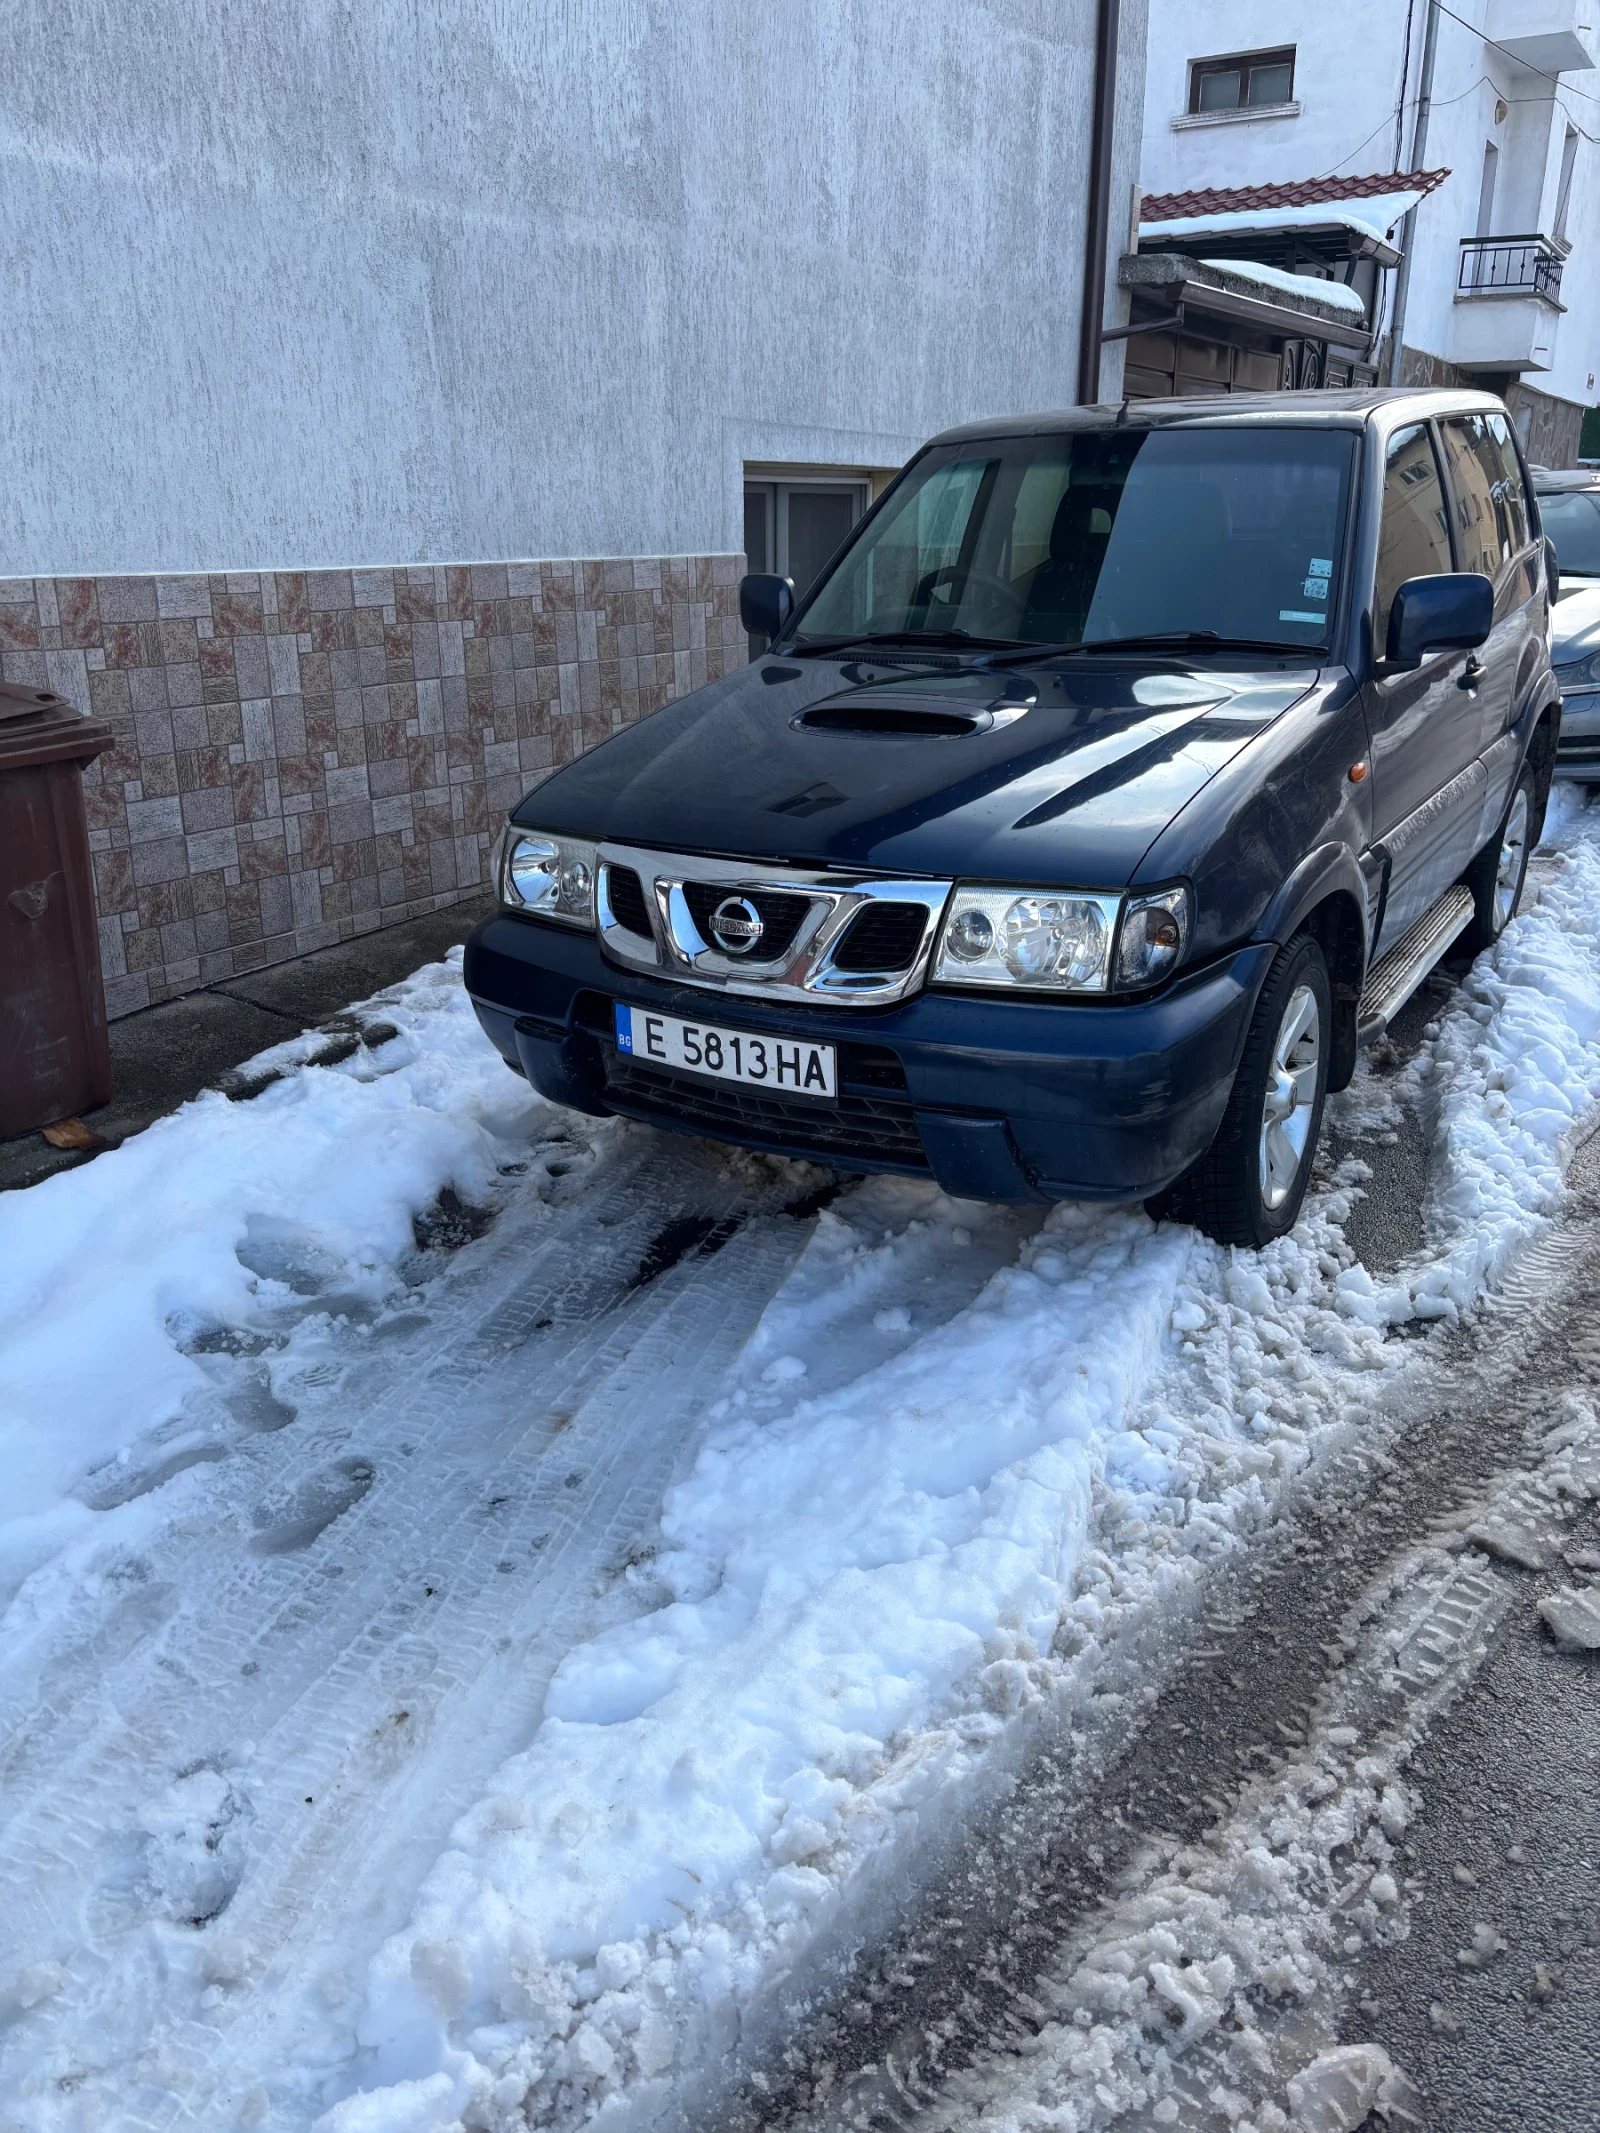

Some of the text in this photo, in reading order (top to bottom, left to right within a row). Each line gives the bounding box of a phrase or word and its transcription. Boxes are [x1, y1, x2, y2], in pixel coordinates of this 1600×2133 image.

[711, 916, 761, 935] NISSAN
[619, 1033, 631, 1047] BG
[646, 1017, 666, 1059] E
